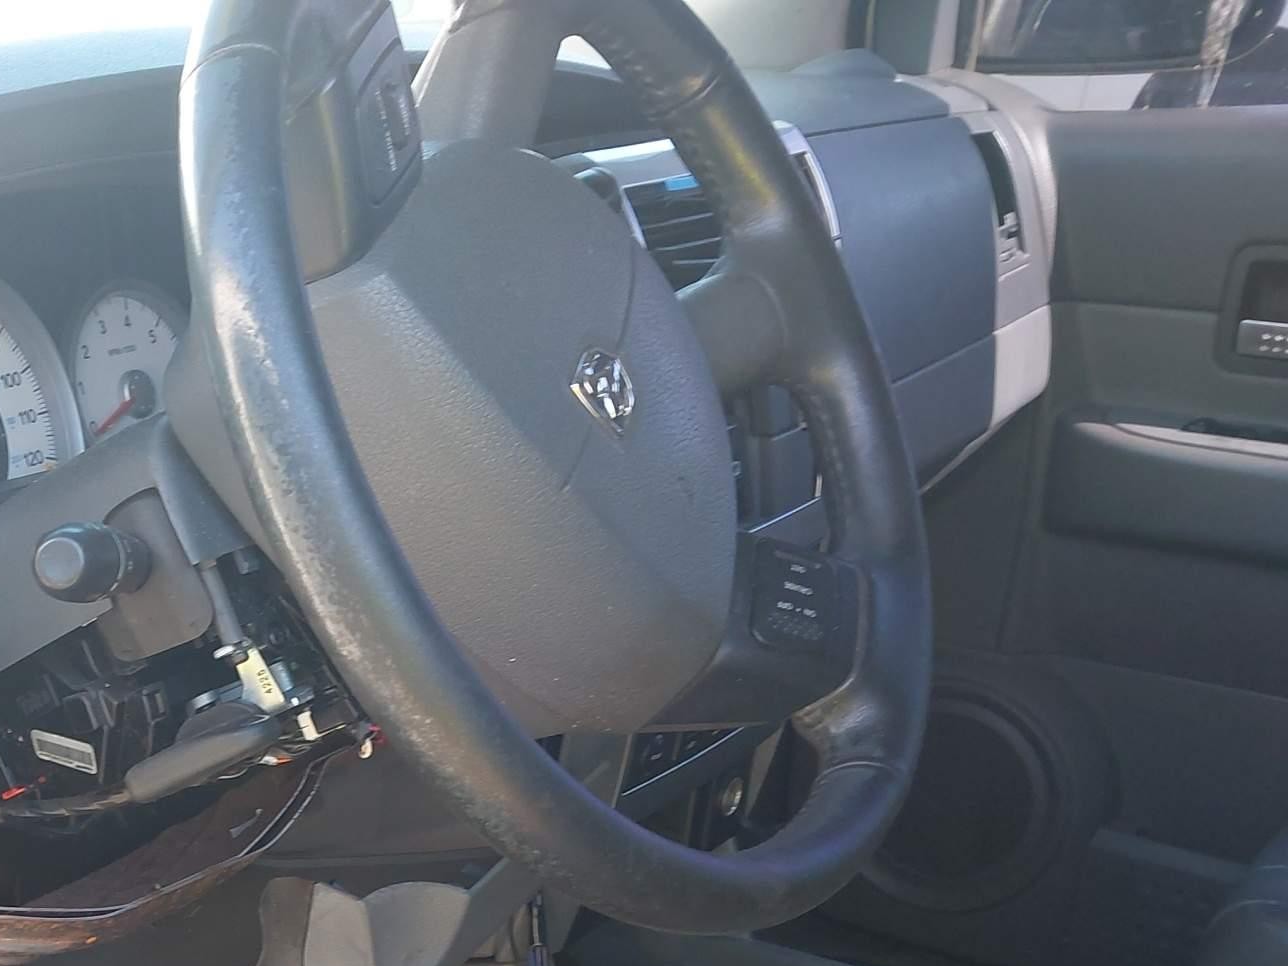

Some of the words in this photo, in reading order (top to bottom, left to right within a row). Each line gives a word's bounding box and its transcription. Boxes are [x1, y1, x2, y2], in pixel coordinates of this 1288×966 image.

[98, 320, 107, 335] 3
[123, 314, 133, 327] 4
[148, 329, 157, 344] 5
[81, 345, 91, 359] 2
[0, 371, 22, 388] 100
[77, 381, 87, 396] 1
[18, 409, 37, 424] 110
[23, 450, 44, 467] 120
